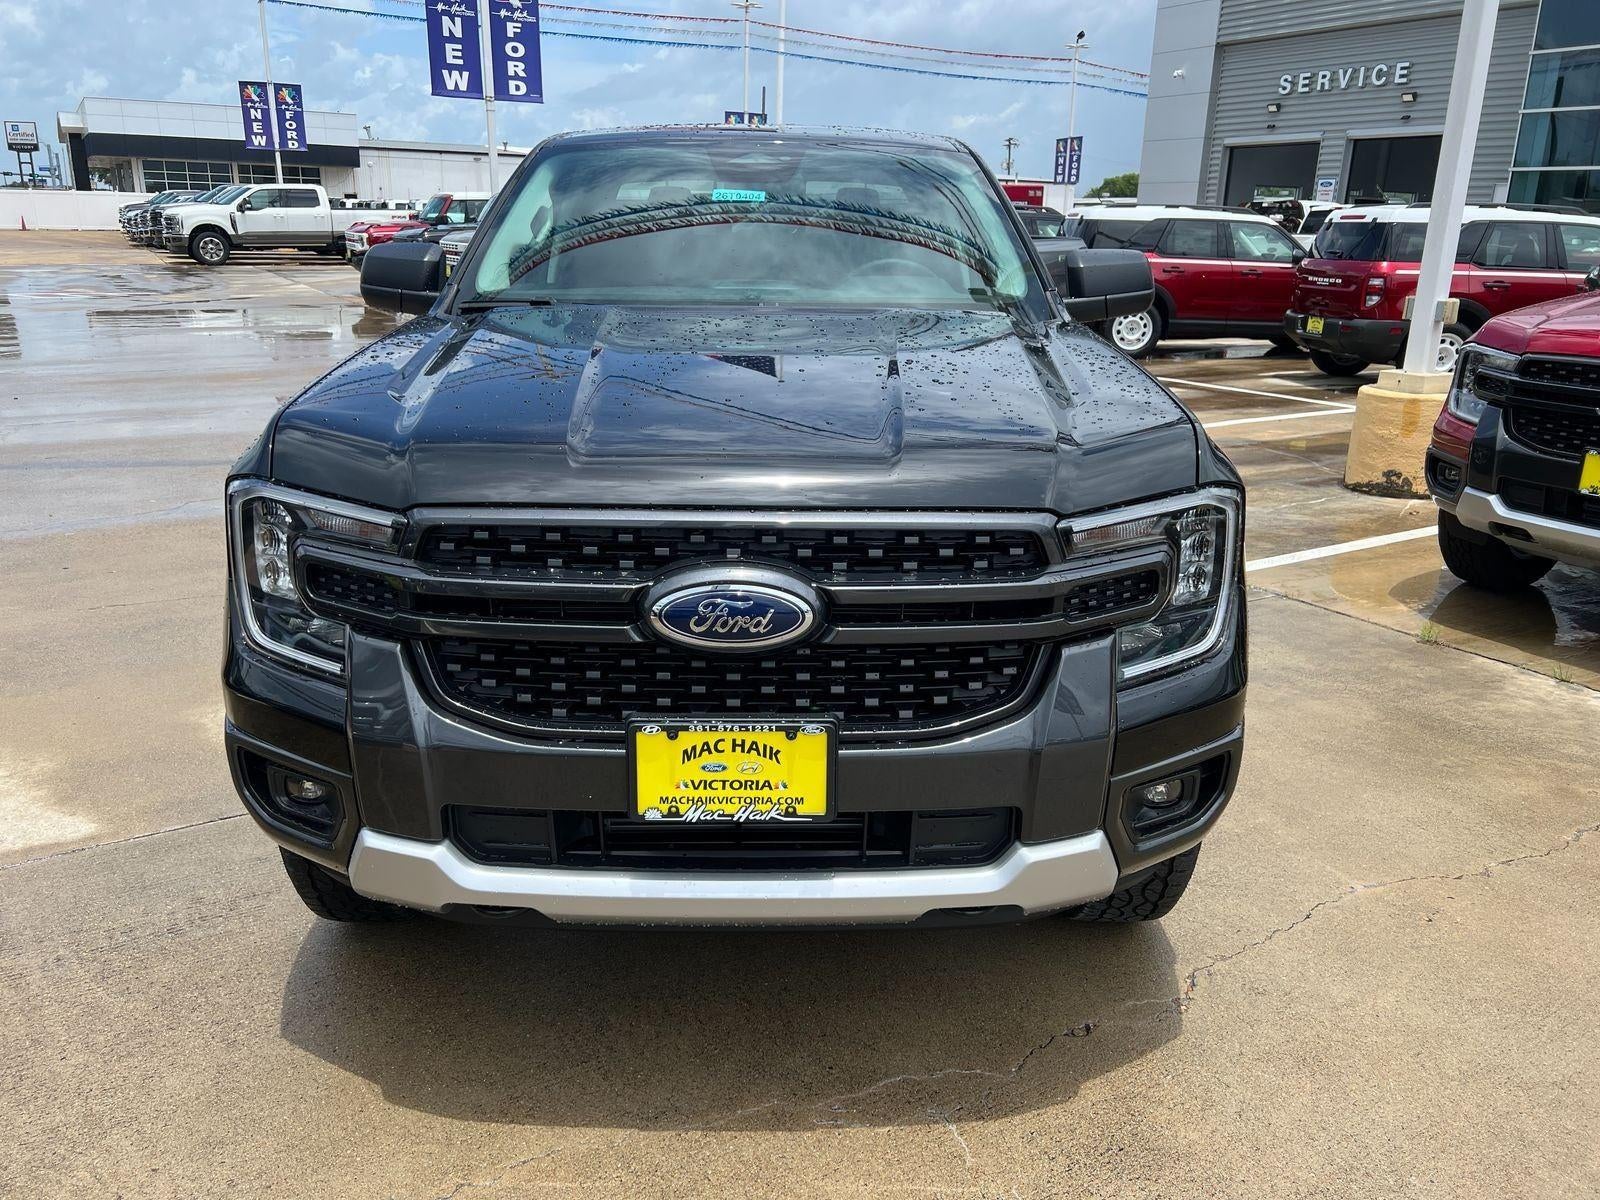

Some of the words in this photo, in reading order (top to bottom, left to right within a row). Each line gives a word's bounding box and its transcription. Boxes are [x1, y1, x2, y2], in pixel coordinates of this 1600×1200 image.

[441, 15, 470, 91] NEW
[504, 21, 527, 96] FORD
[1278, 61, 1410, 95] SERVICE
[250, 108, 267, 146] NEW
[285, 111, 299, 149] FORD
[1056, 156, 1064, 183] NEW
[1070, 155, 1078, 182] FORD
[715, 192, 762, 200] 26T0404
[1308, 276, 1342, 284] BRONCO
[689, 598, 774, 633] Ford
[681, 738, 726, 765] MAC
[731, 738, 781, 765] HAIK
[689, 779, 773, 791] VICTORIA
[659, 796, 804, 806] MACHAIKVICTORIA.COM
[682, 804, 730, 822] Mac
[732, 804, 784, 822] Haik
